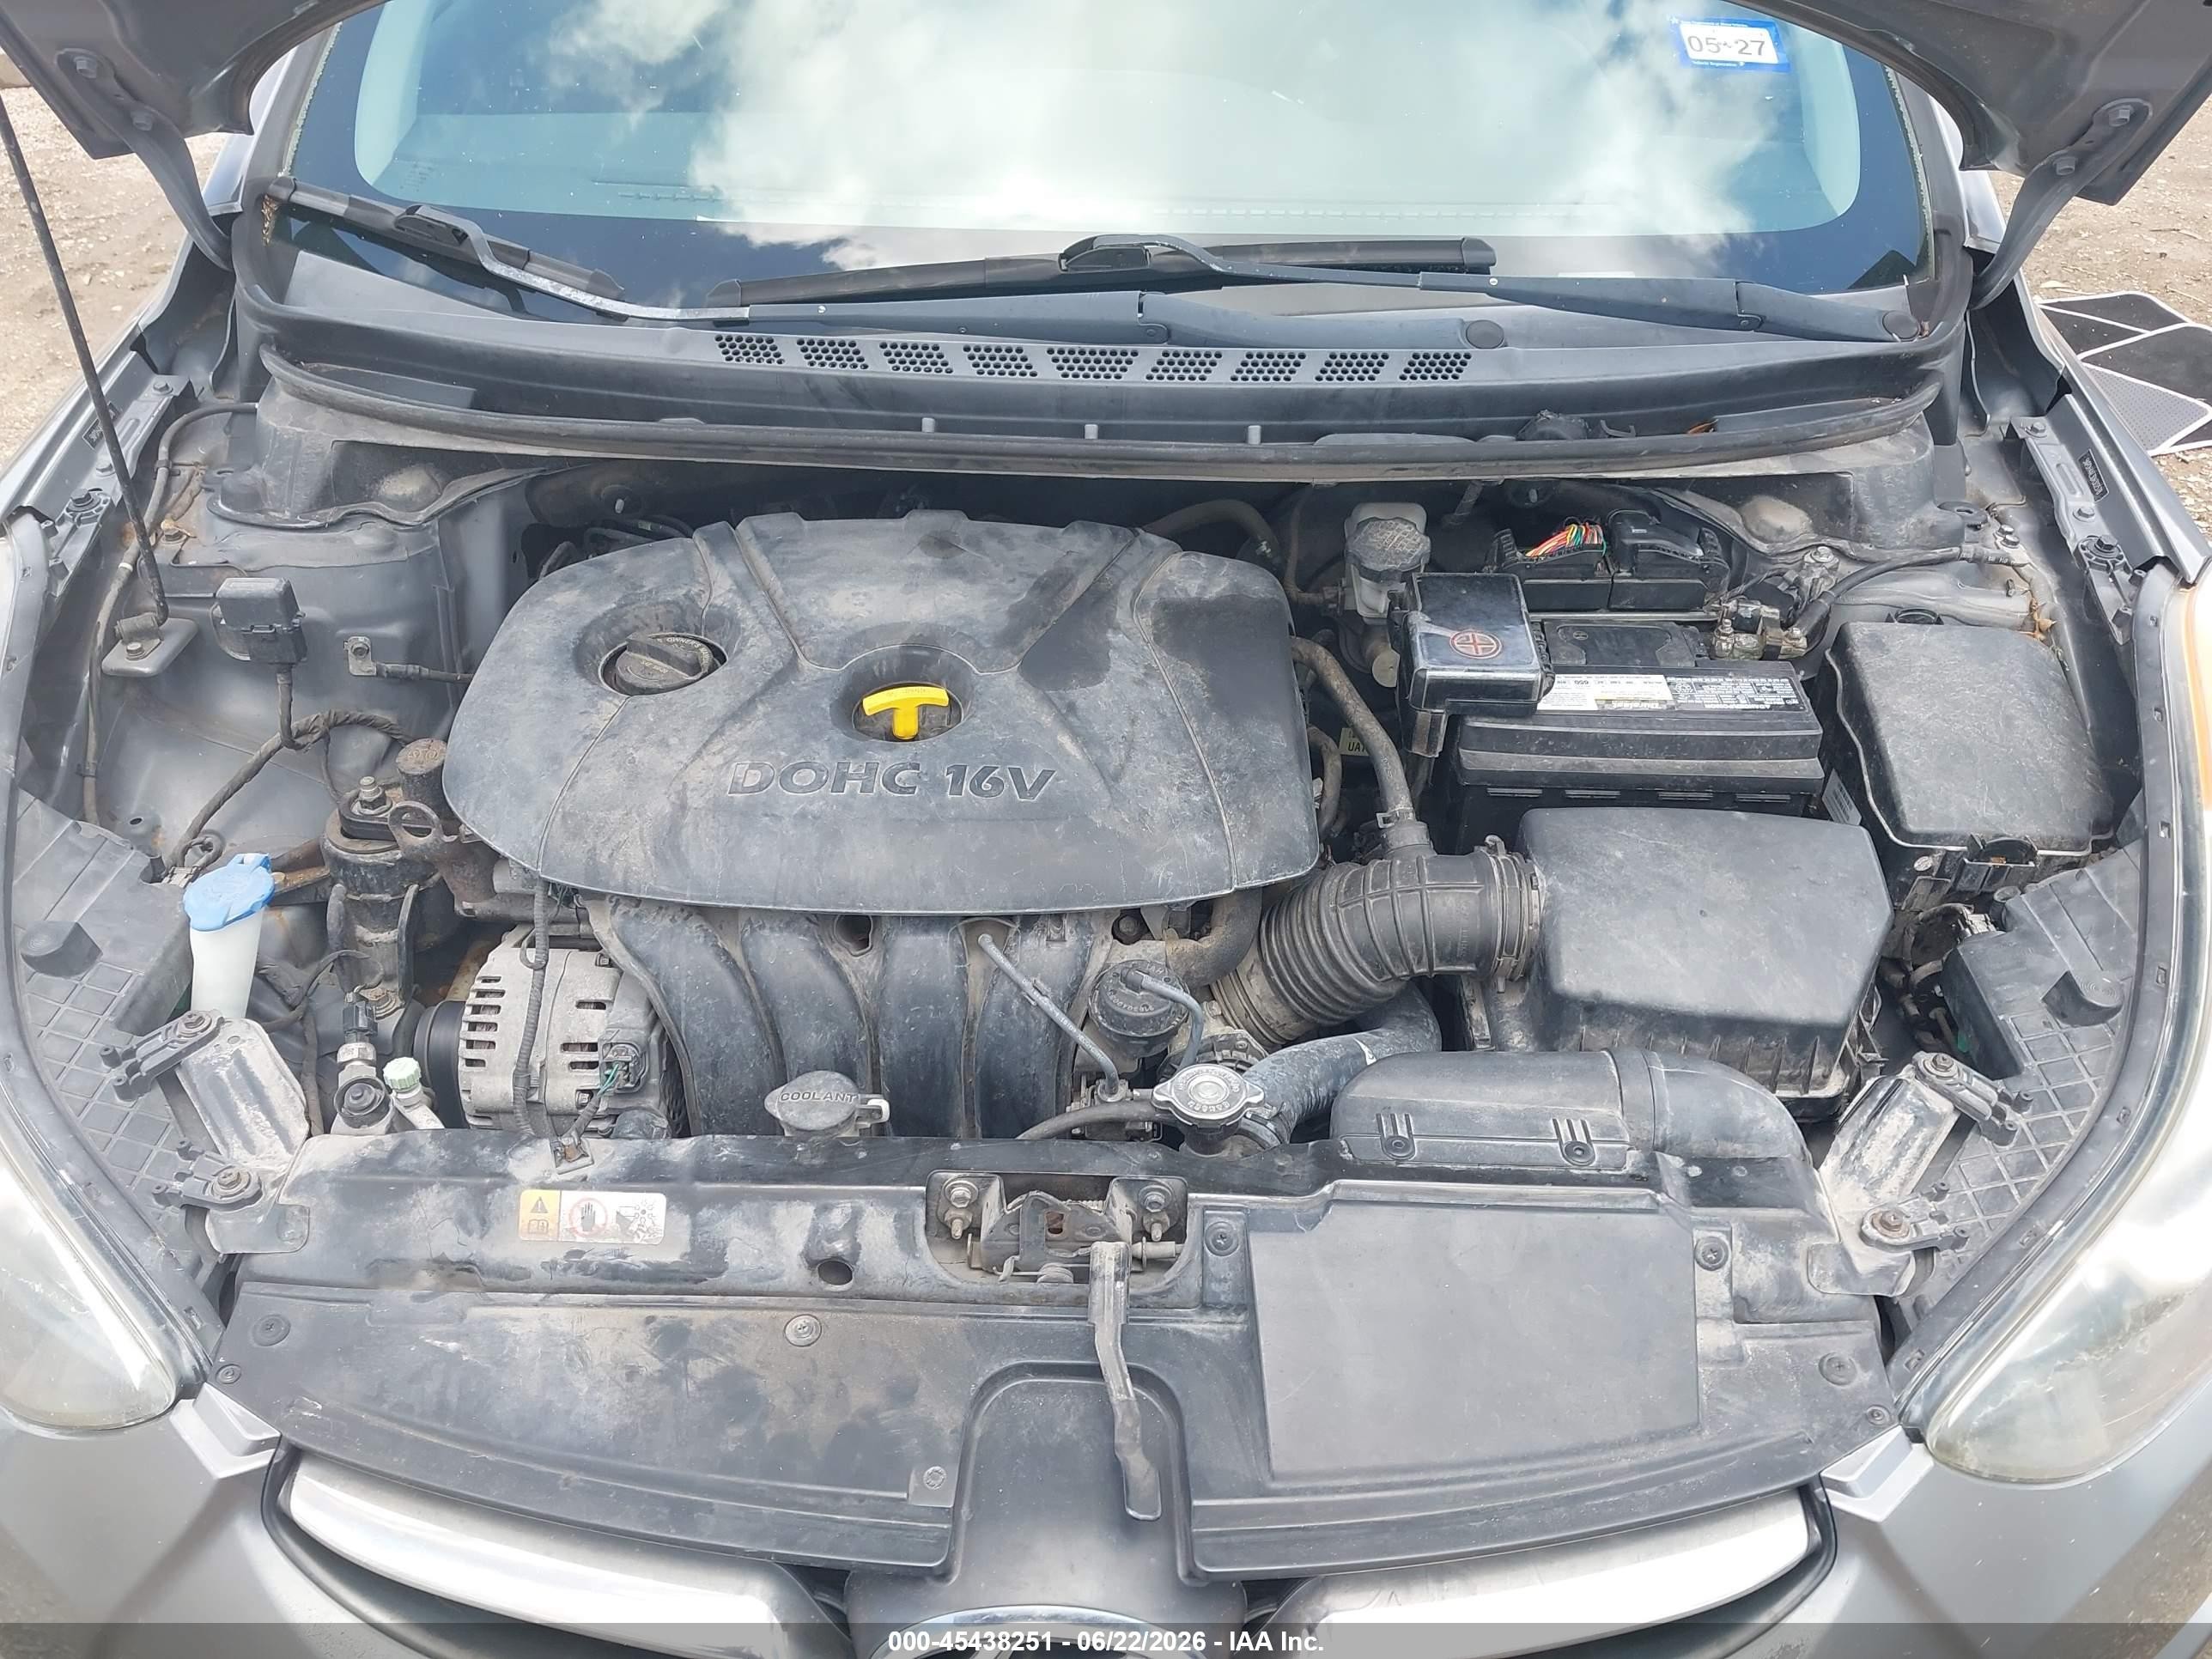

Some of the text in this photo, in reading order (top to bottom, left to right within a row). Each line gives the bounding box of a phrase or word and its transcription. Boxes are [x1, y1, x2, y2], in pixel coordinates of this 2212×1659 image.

[1687, 35, 1765, 56] 05 27
[727, 761, 1056, 800] DOHC 16V
[780, 1091, 858, 1103] COOLANT
